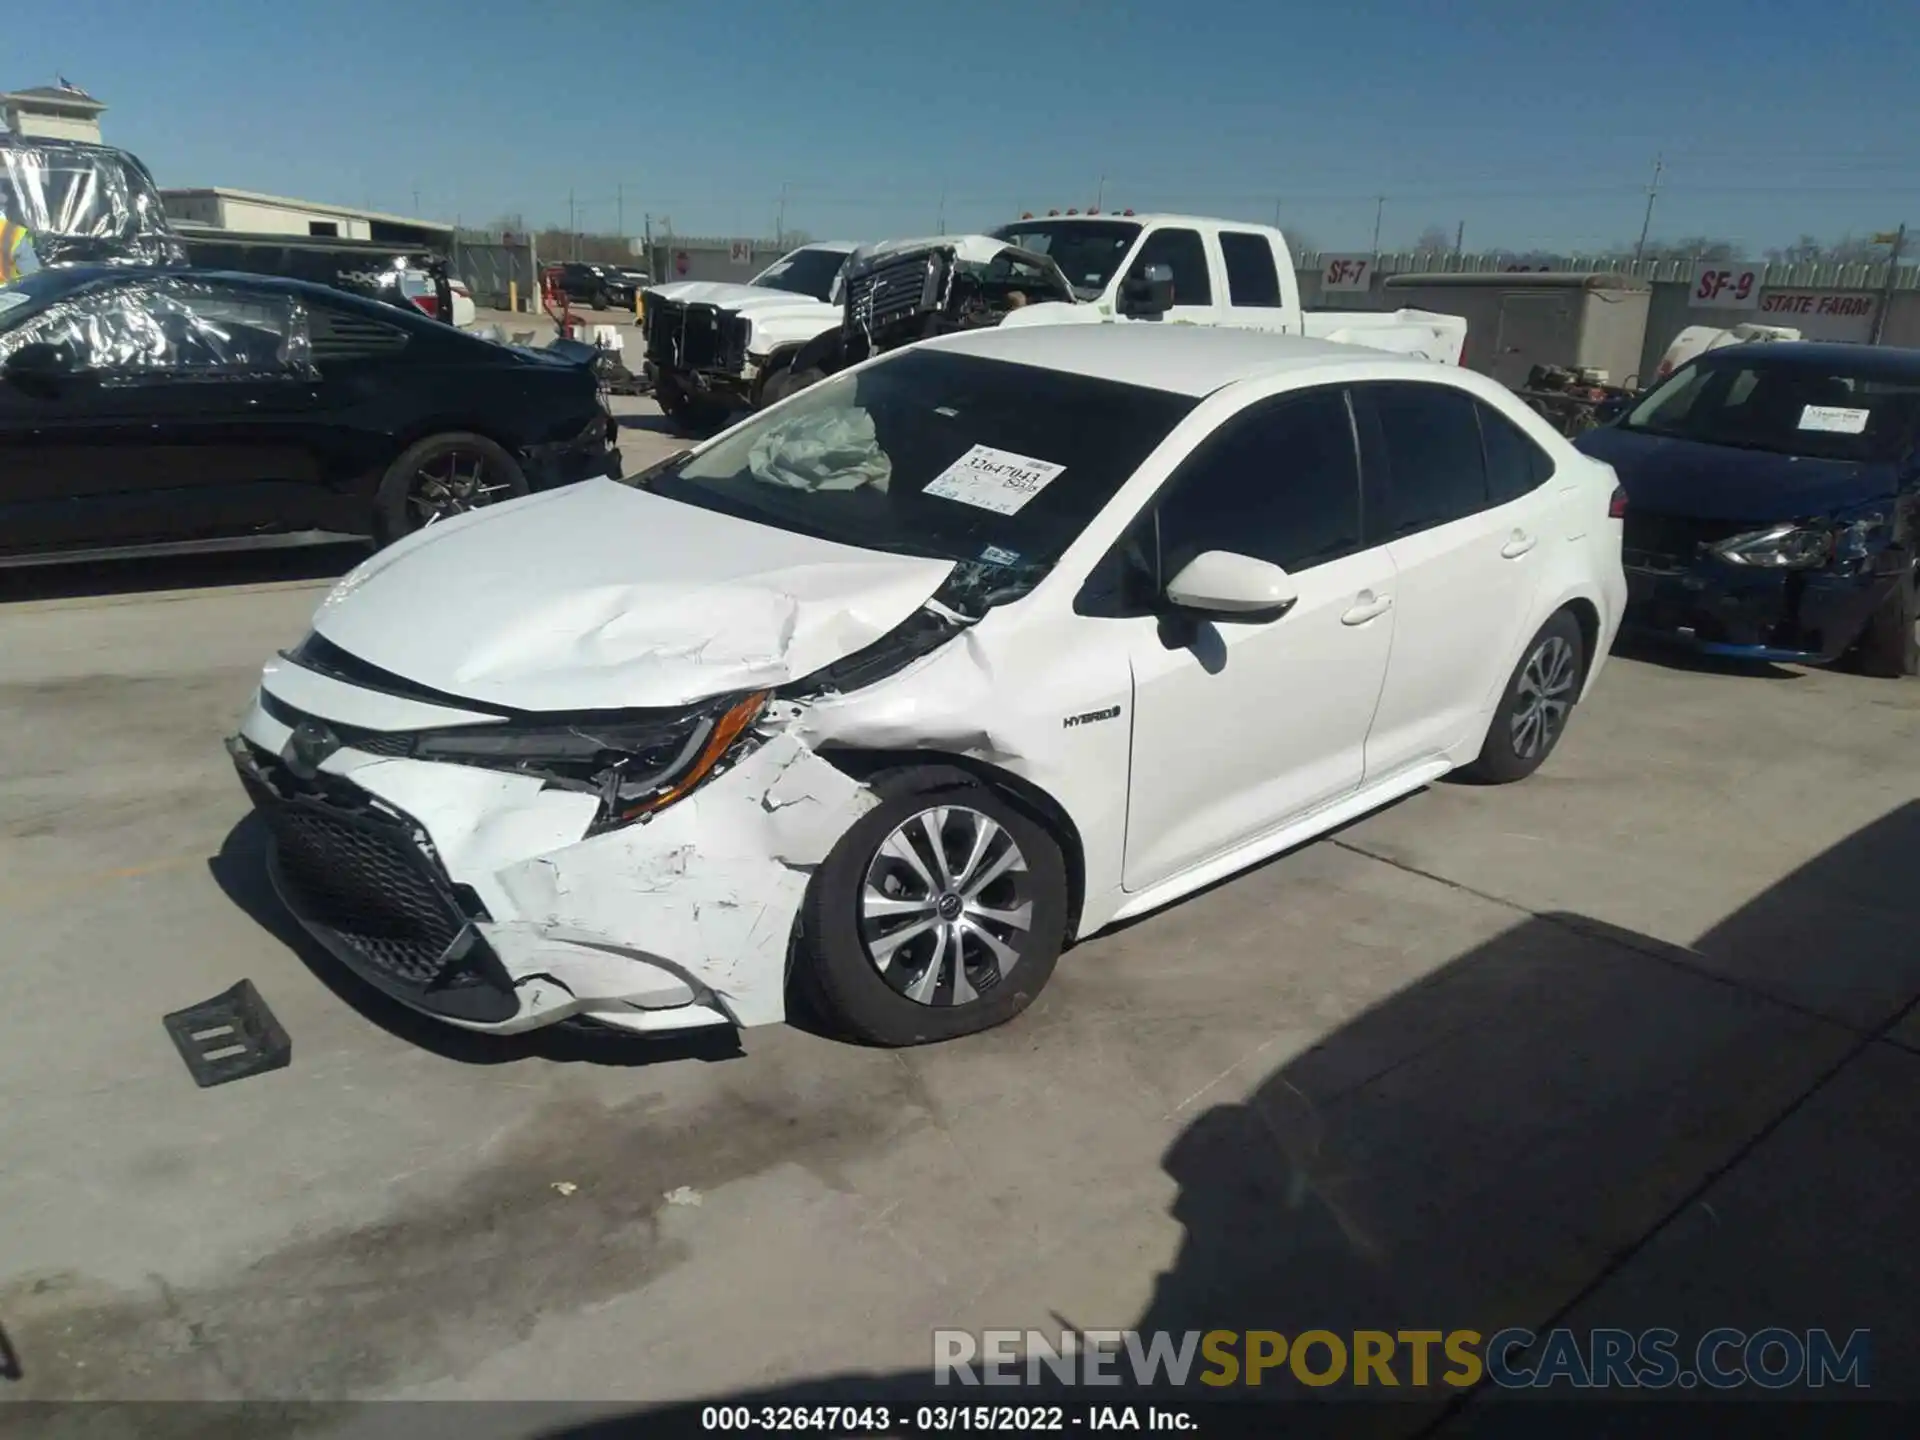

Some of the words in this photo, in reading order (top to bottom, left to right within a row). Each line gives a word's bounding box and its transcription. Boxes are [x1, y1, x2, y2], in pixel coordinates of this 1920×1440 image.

[1328, 260, 1367, 285] SF-7
[1697, 270, 1755, 300] SF-9
[1762, 294, 1811, 314] STATE
[1816, 295, 1872, 317] FARM
[1063, 708, 1112, 729] HYBRID
